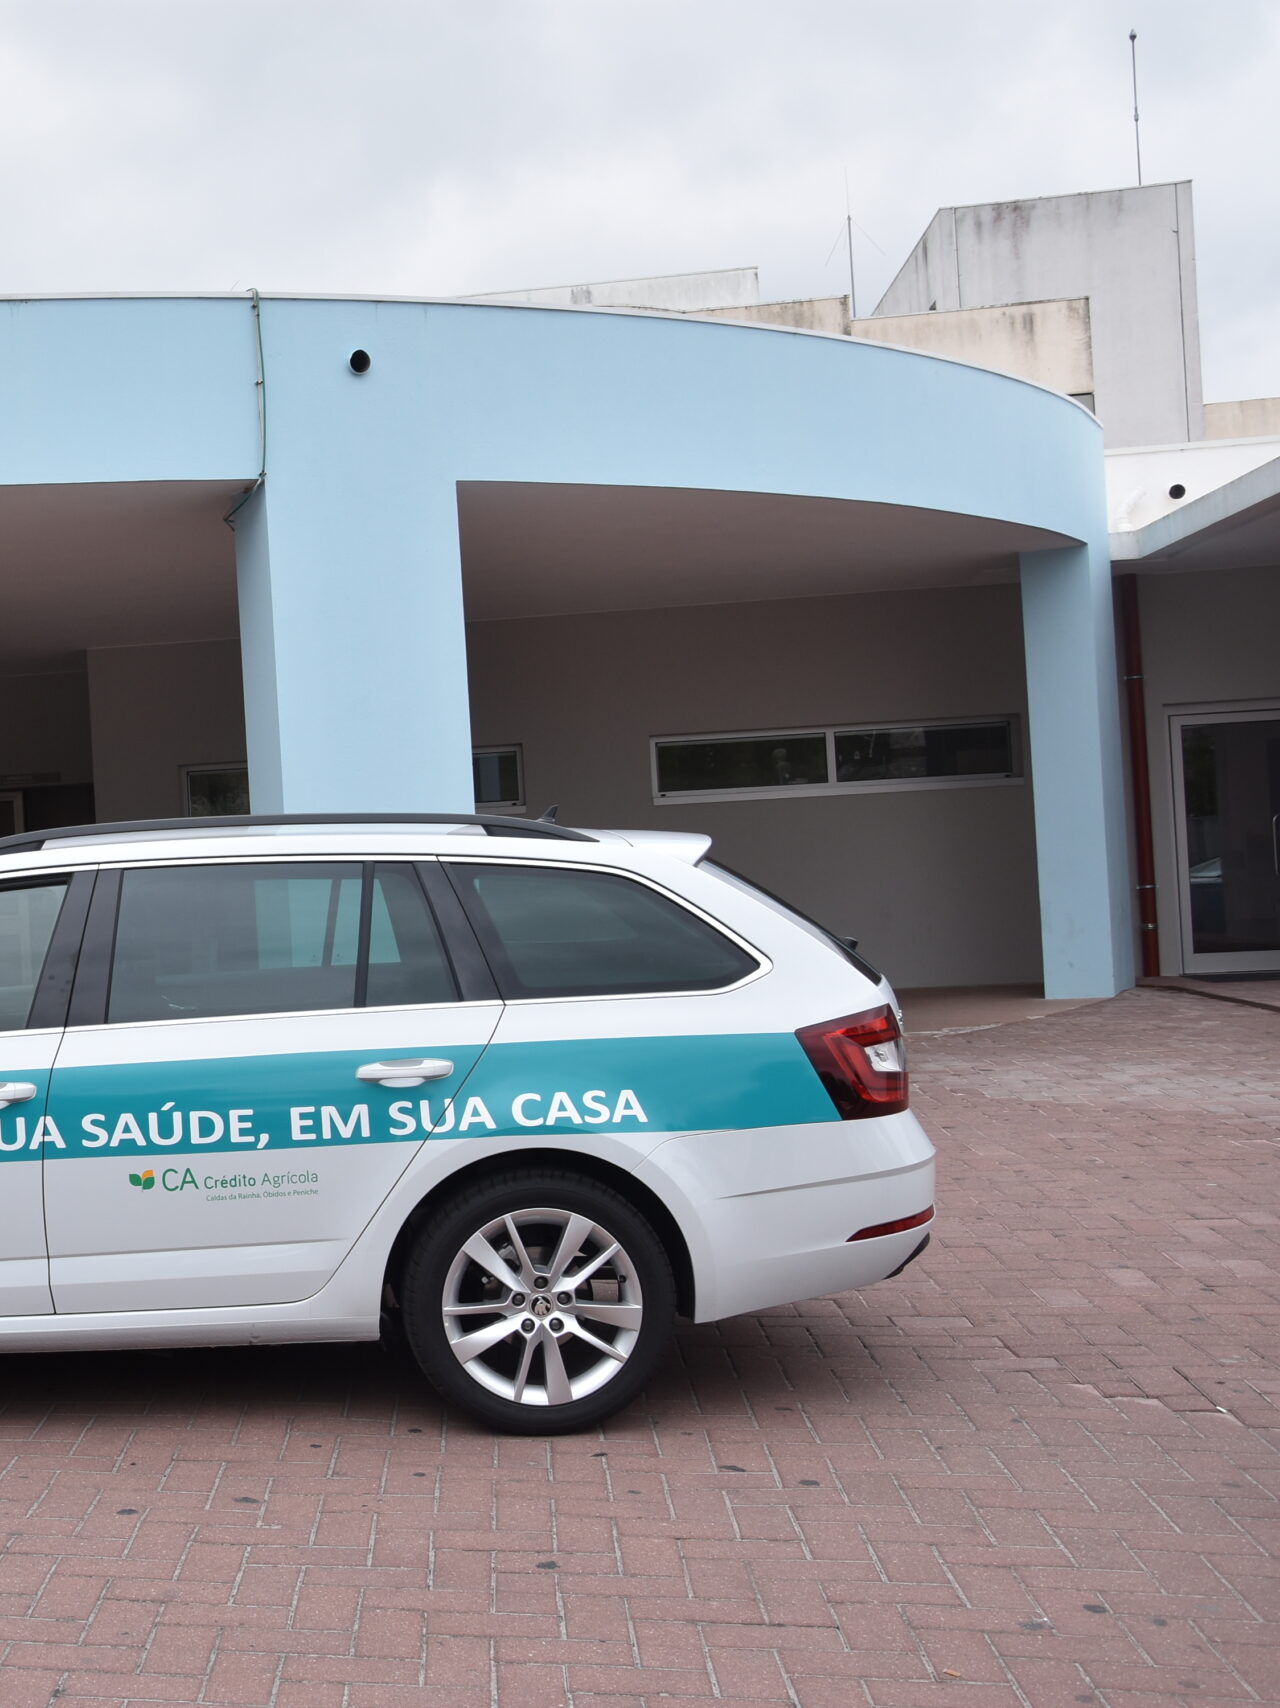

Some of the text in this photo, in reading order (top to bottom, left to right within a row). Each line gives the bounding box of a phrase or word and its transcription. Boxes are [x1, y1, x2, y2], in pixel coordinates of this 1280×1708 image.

[81, 1102, 269, 1150] SAÚDE,
[290, 1103, 372, 1141] EM
[388, 1096, 497, 1136] SUA
[511, 1089, 648, 1128] CASA
[162, 1167, 318, 1191] CA Crédito Agrícola
[206, 1192, 227, 1202] Caldas
[228, 1192, 237, 1201] da
[262, 1189, 286, 1198] Óbidos
[293, 1188, 319, 1196] Peniche
